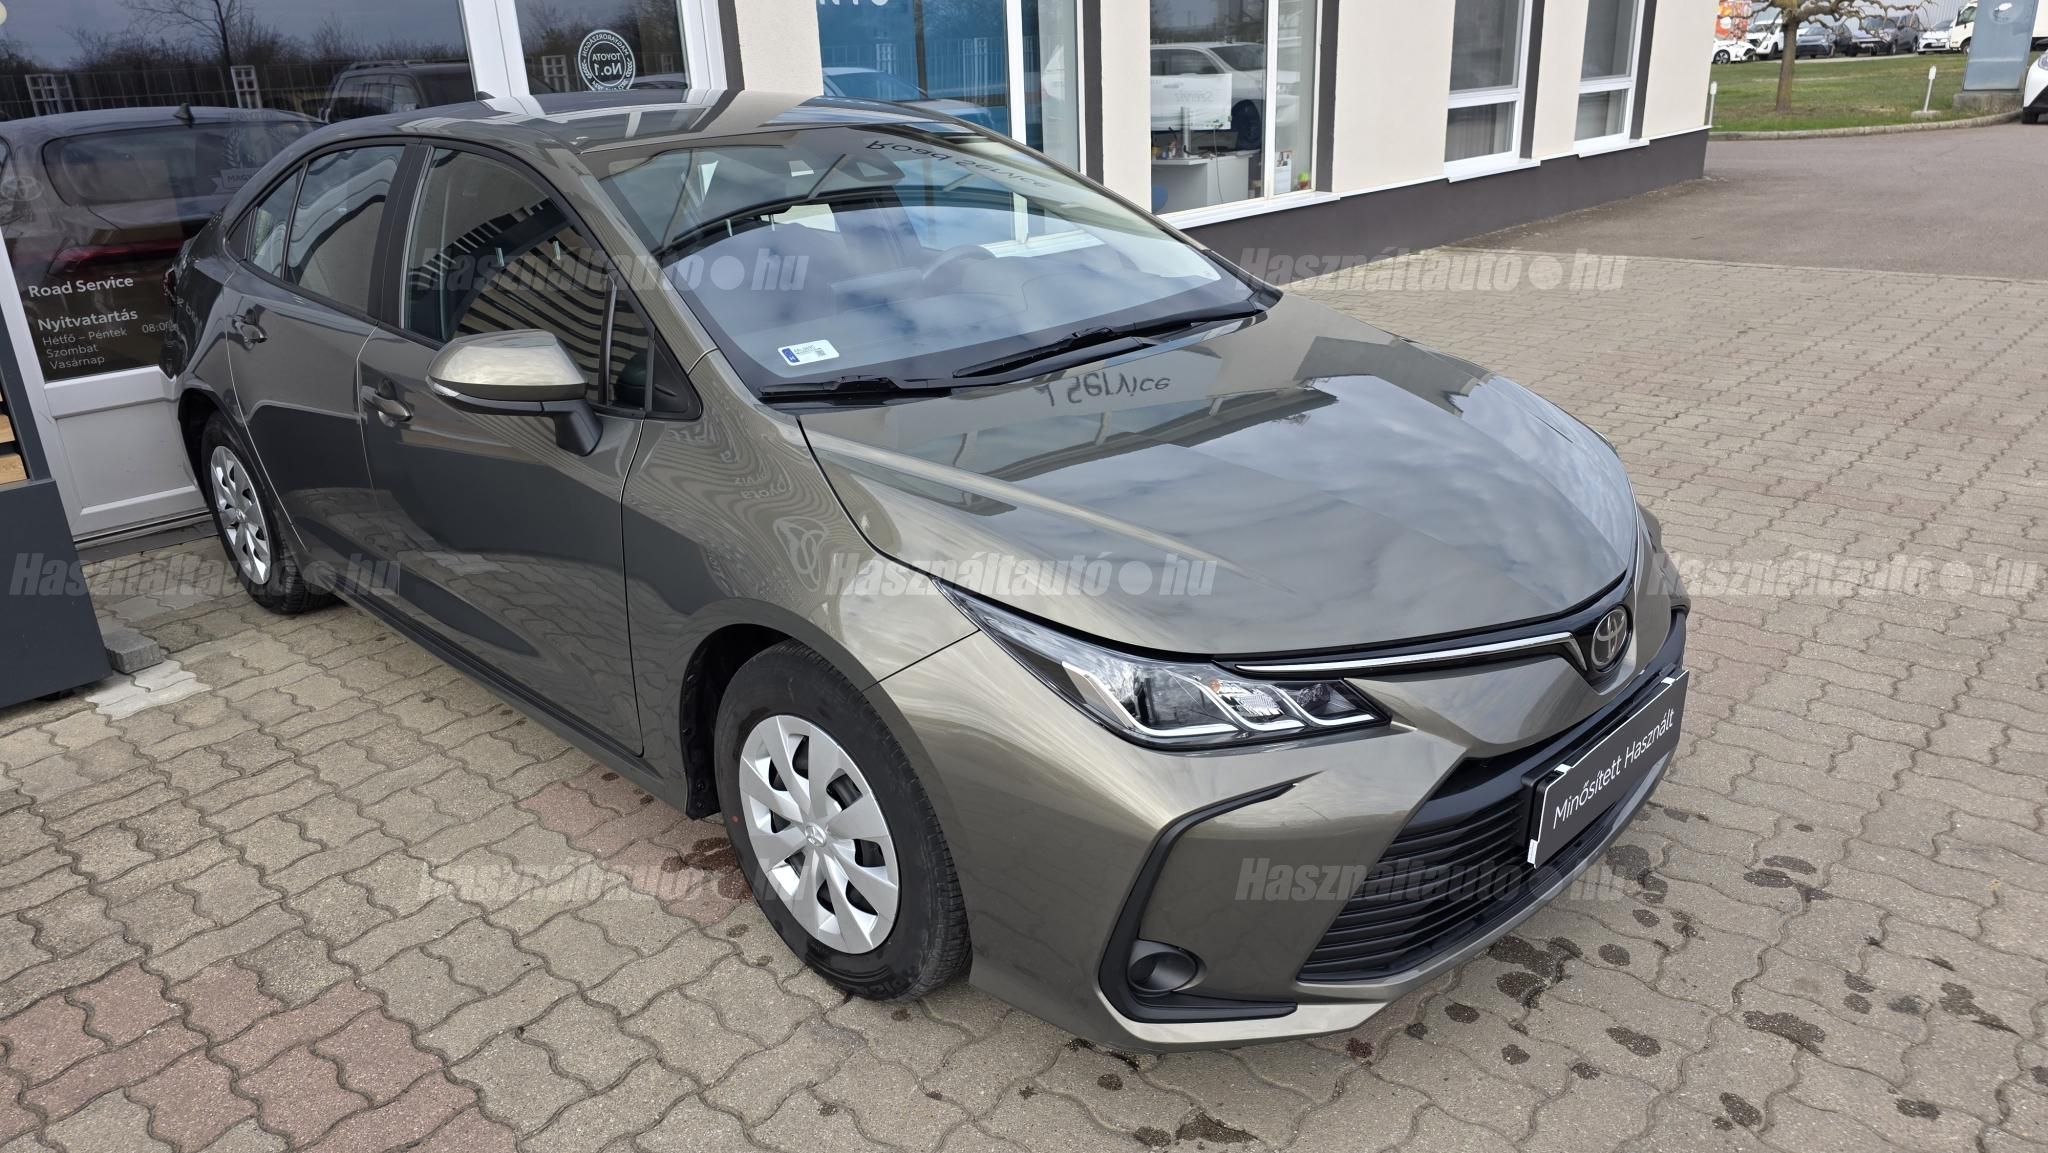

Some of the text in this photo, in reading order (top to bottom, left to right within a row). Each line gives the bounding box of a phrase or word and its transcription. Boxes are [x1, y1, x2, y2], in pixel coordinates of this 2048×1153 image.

[28, 276, 134, 298] Road Service
[38, 308, 139, 333] Nyitvatartás
[42, 333, 76, 347] Hétfő
[88, 327, 128, 341] Péntek
[46, 344, 99, 359] Szombat
[49, 355, 105, 370] Vasárnap
[1553, 708, 1675, 829] Minősített Használt
